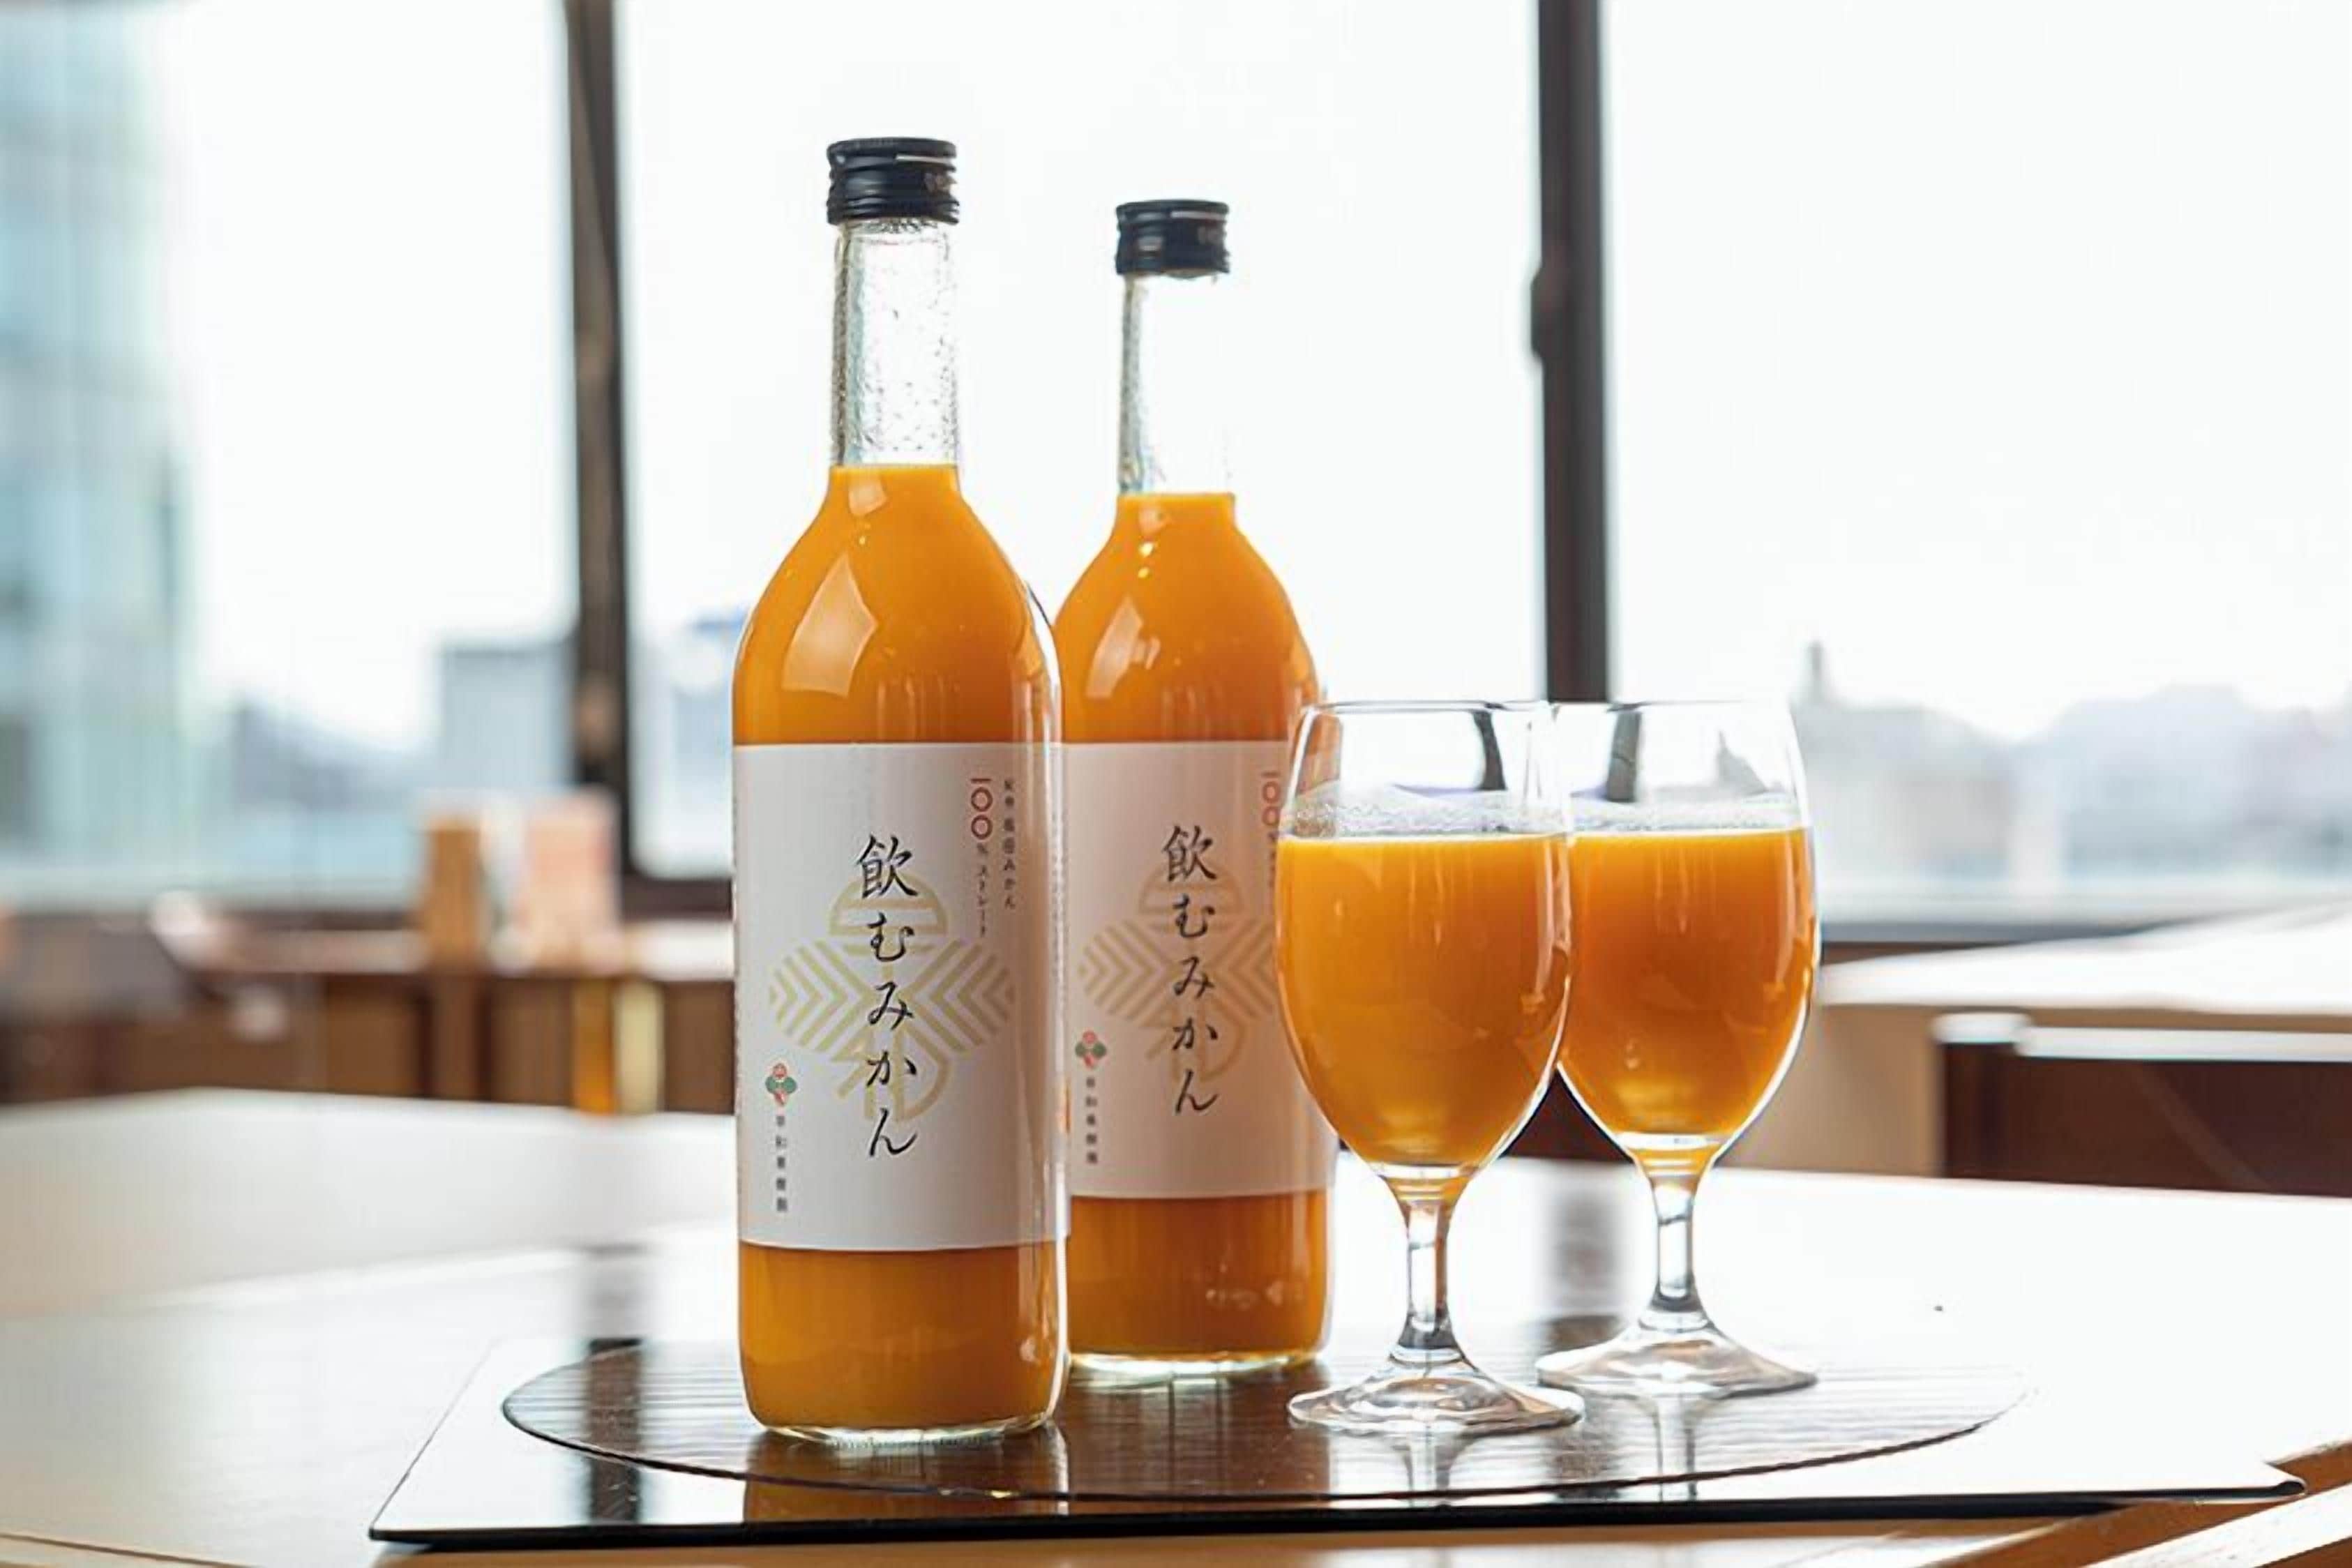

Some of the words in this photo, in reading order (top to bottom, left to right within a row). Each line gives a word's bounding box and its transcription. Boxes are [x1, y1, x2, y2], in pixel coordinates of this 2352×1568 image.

[856, 834, 919, 1156] 飲むみかん
[1162, 824, 1219, 1114] 飲むみかん
